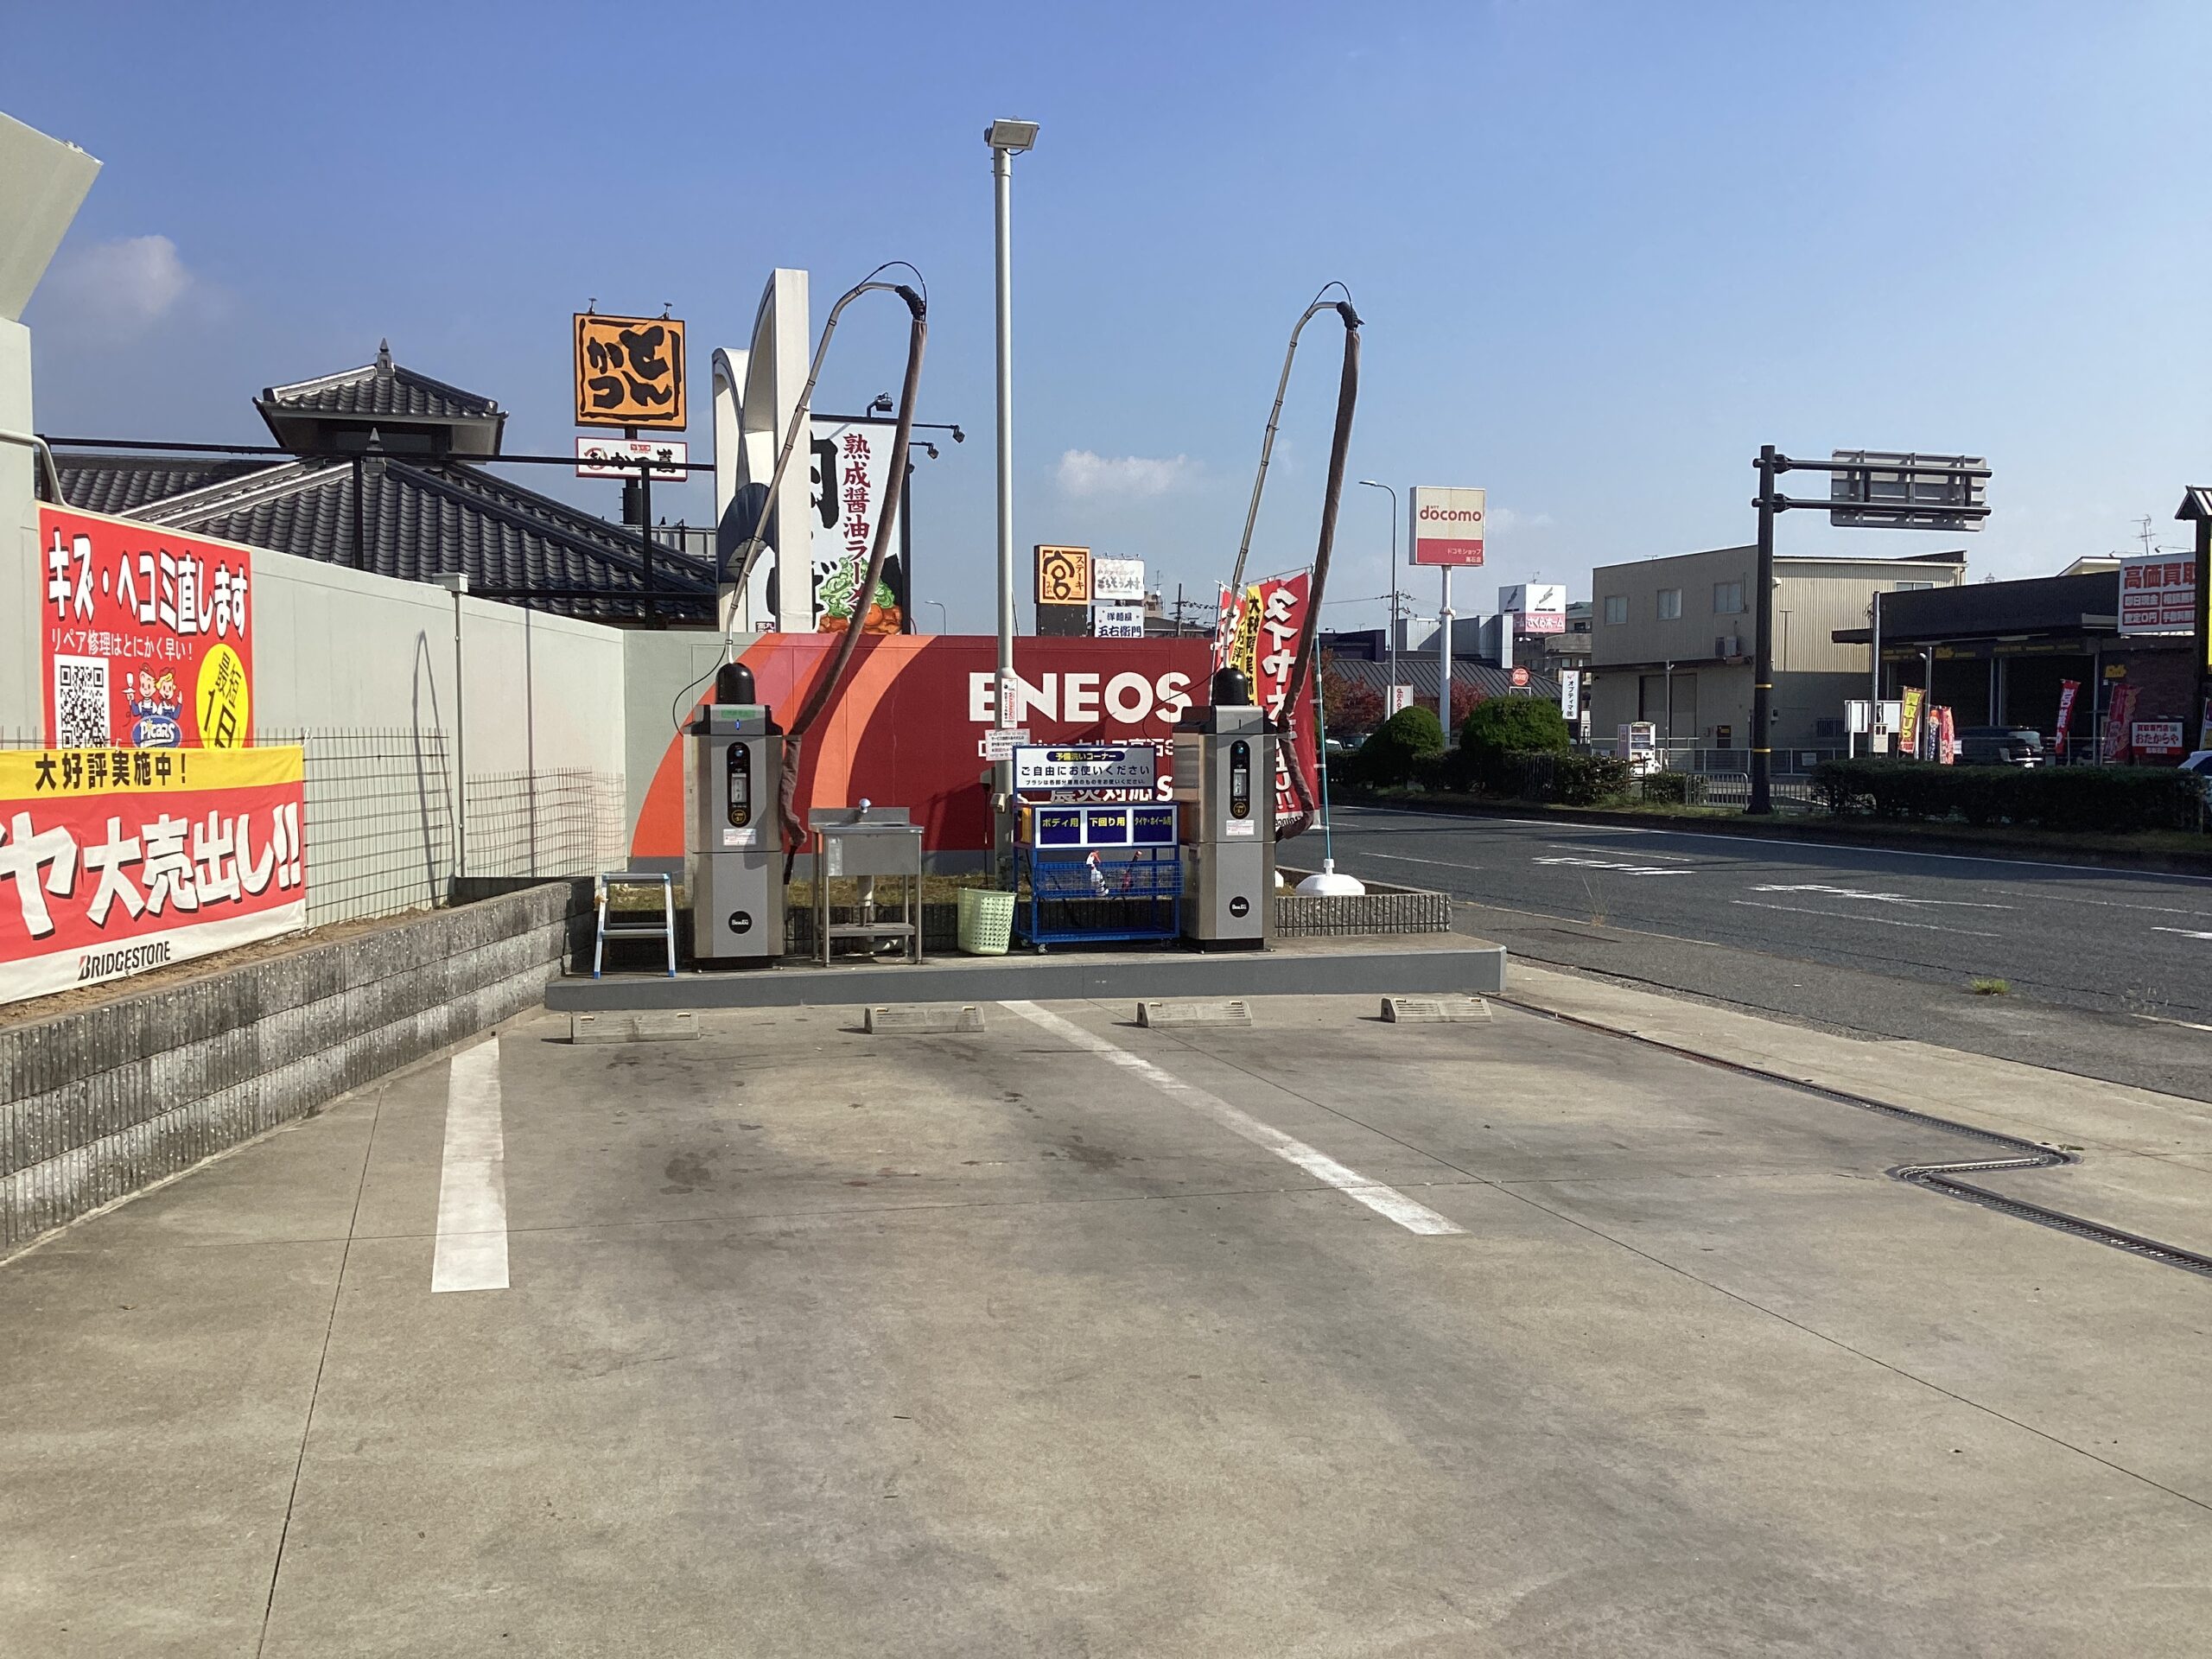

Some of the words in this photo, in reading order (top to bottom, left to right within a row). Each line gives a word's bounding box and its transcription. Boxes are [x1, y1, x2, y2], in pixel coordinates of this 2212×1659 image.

[1420, 505, 1482, 522] docomo
[842, 433, 871, 613] 熟成醤油ラーメ
[1075, 556, 1084, 590] ステーキ
[48, 526, 248, 639] キズ・ヘコミ直します
[1097, 576, 1141, 590] ごちそう村
[1527, 617, 1564, 630] さくらホーム
[1098, 625, 1142, 638] 五右衛門
[52, 627, 193, 662] リペア修理はとにかく早い!
[969, 671, 1192, 723] ENEOS
[2135, 732, 2179, 746] おたからや
[1055, 753, 1116, 761] 予備洗いコーナー
[35, 751, 188, 791] 大好評実施中!
[1020, 766, 1150, 777] ご自由にお使いください
[1042, 817, 1079, 828] ボディ用
[1089, 817, 1126, 827] 下回り用
[1135, 817, 1172, 825] タイヤ・ホイール用
[0, 802, 301, 937] ヤ大売出し!!
[78, 940, 171, 982] BRIDGESTONE
